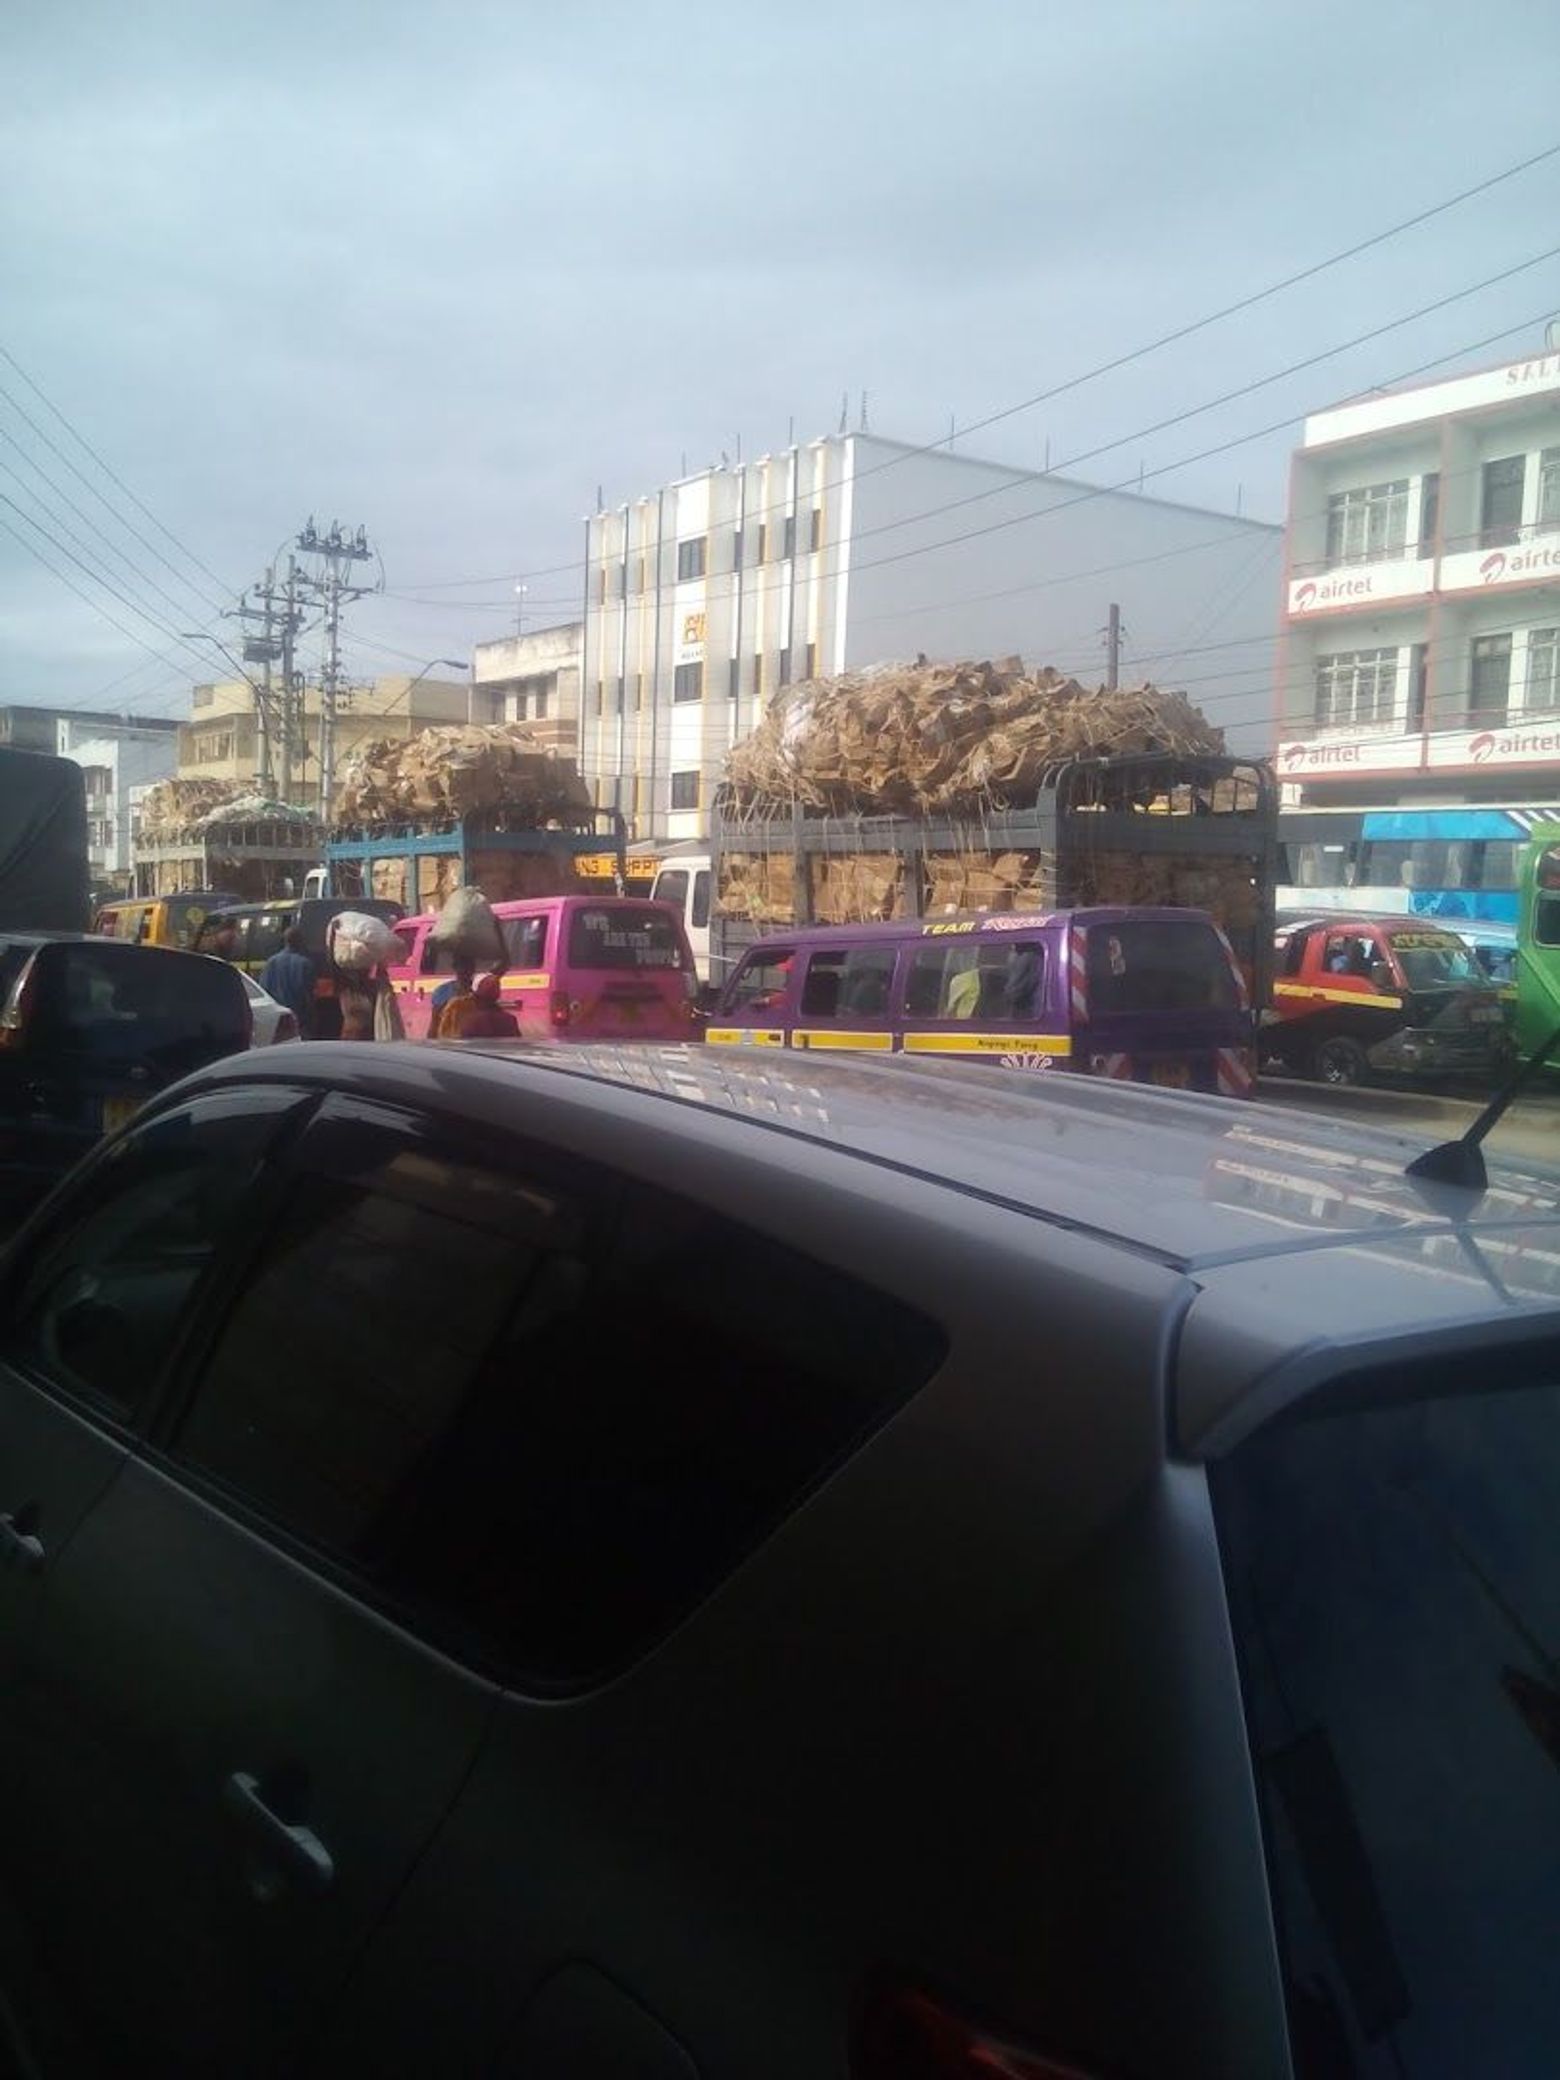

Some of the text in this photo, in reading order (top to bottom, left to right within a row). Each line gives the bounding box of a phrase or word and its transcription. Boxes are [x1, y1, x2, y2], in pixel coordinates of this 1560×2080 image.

[1510, 550, 1560, 571] airte
[1320, 576, 1373, 599] airtel
[1500, 733, 1560, 754] airtel
[1308, 745, 1360, 766] airtel
[922, 921, 976, 935] TEAM
